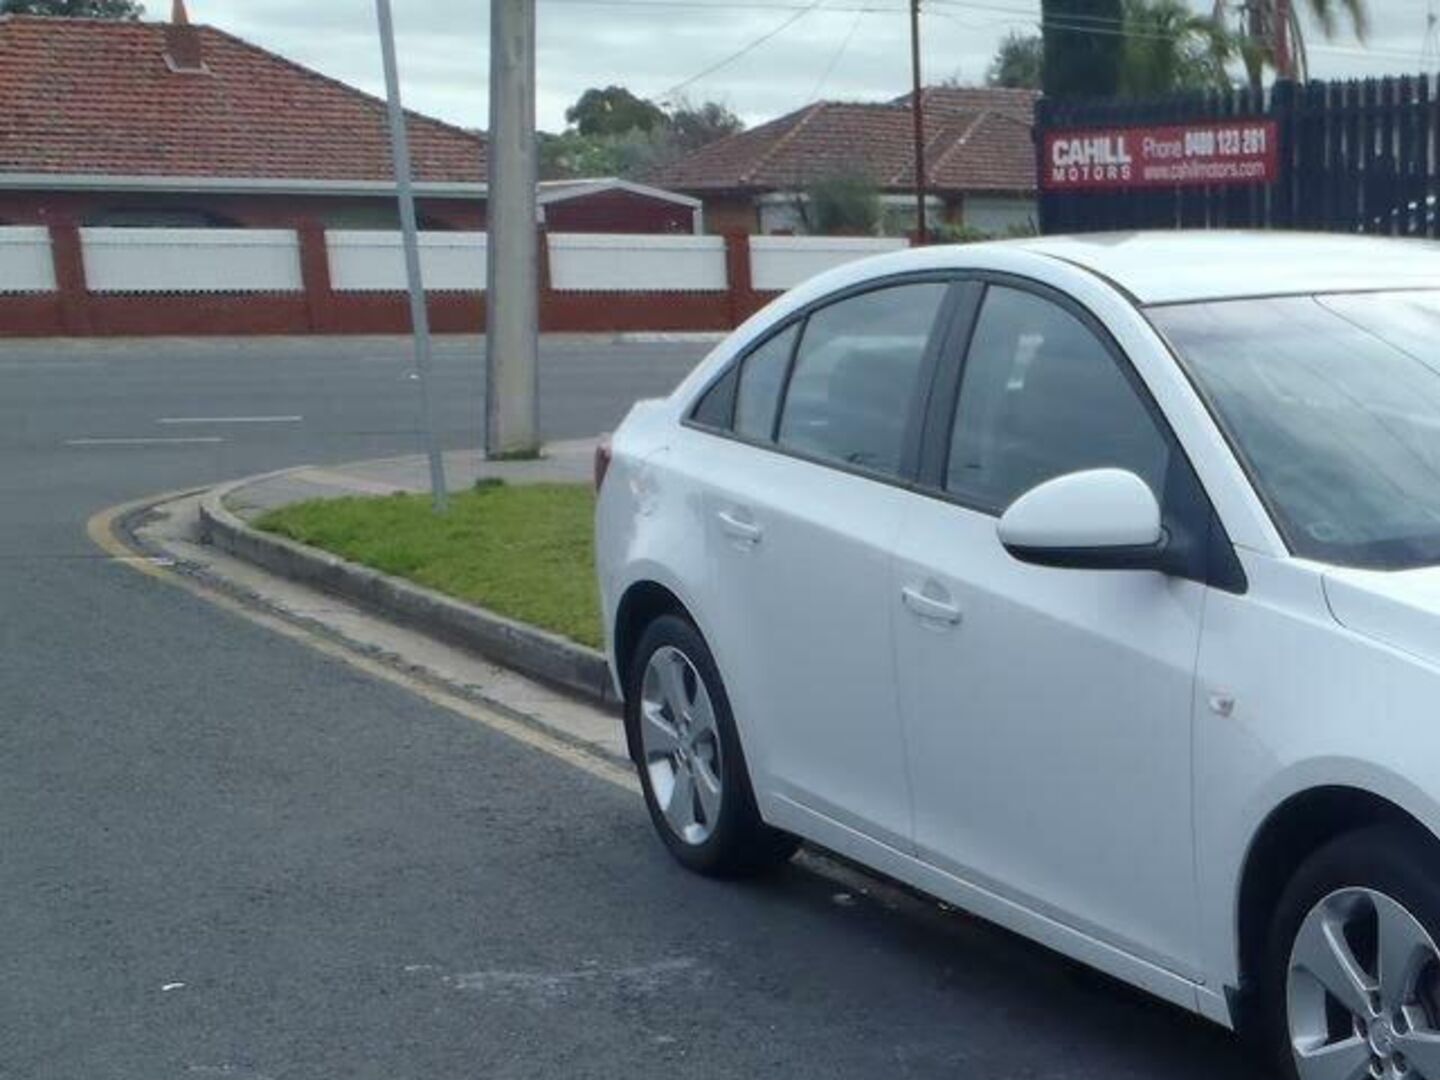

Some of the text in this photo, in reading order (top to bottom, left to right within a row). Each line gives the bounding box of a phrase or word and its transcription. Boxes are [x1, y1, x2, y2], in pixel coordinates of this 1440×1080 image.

[1053, 136, 1132, 165] CAHILL
[1142, 137, 1182, 158] Phone
[1217, 129, 1241, 155] 123
[1053, 165, 1132, 182] MOTORS
[1143, 161, 1265, 181] www.cahillmotors.com
